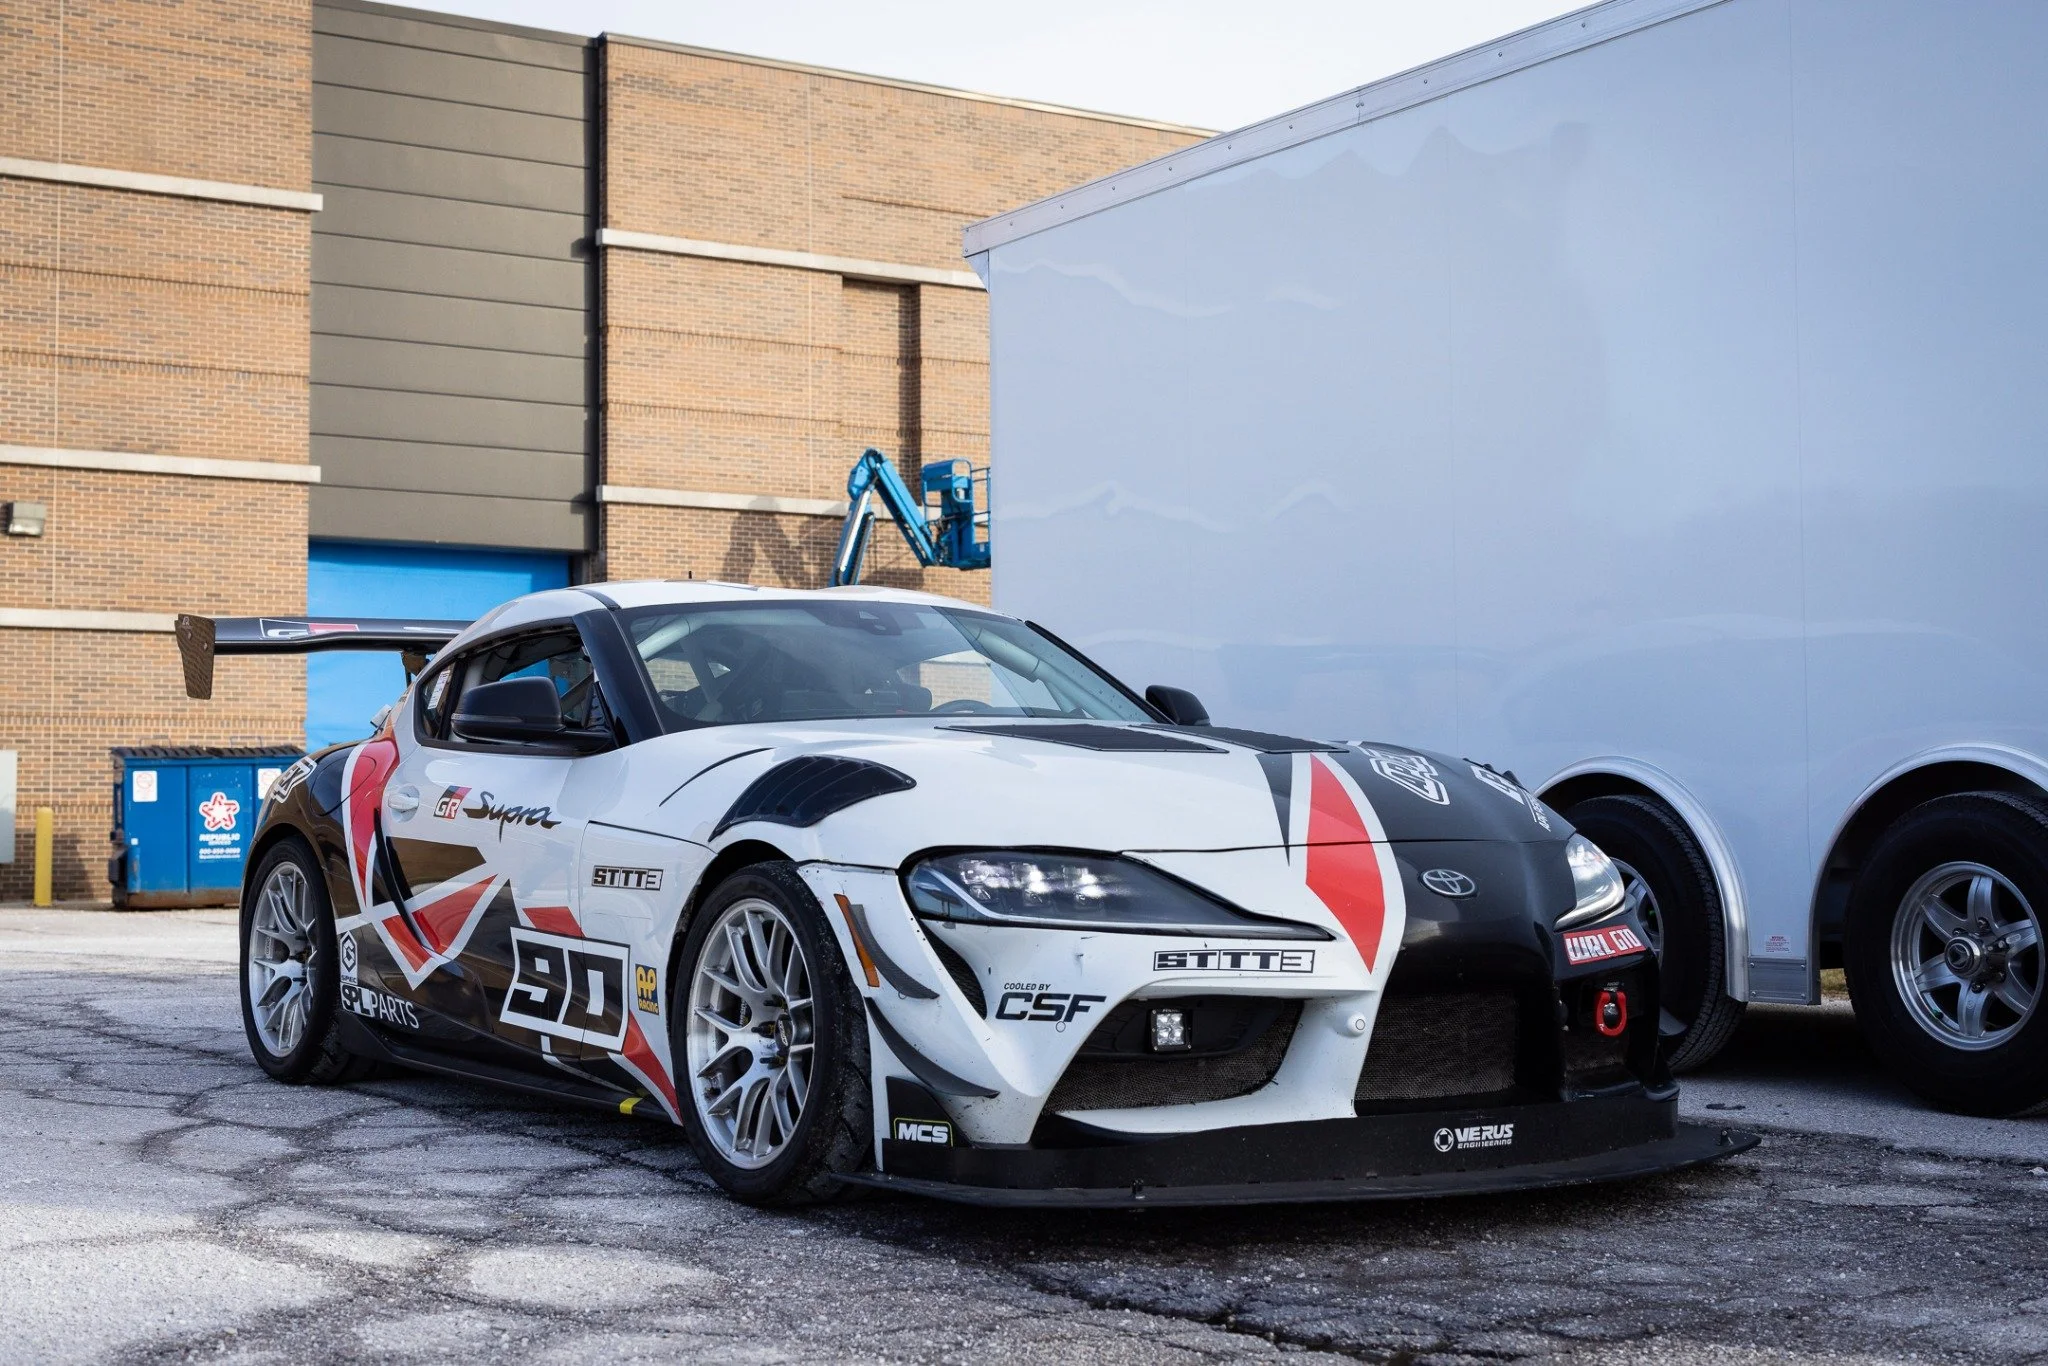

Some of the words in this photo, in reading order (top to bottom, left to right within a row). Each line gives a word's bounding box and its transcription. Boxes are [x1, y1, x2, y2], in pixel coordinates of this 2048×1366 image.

[434, 797, 461, 819] GR
[463, 790, 562, 843] Supra
[1565, 933, 1616, 962] WRL
[341, 974, 357, 984] SPEC
[506, 938, 624, 1038] 90
[636, 966, 657, 1000] AP
[1003, 982, 1037, 991] COOLED
[1038, 983, 1052, 991] BY
[370, 991, 420, 1029] PARTS
[638, 998, 660, 1014] RACING
[995, 991, 1107, 1023] CSF
[898, 1122, 949, 1144] MCS
[1454, 1123, 1514, 1142] VERUS
[1457, 1138, 1512, 1149] ENGINEERING
